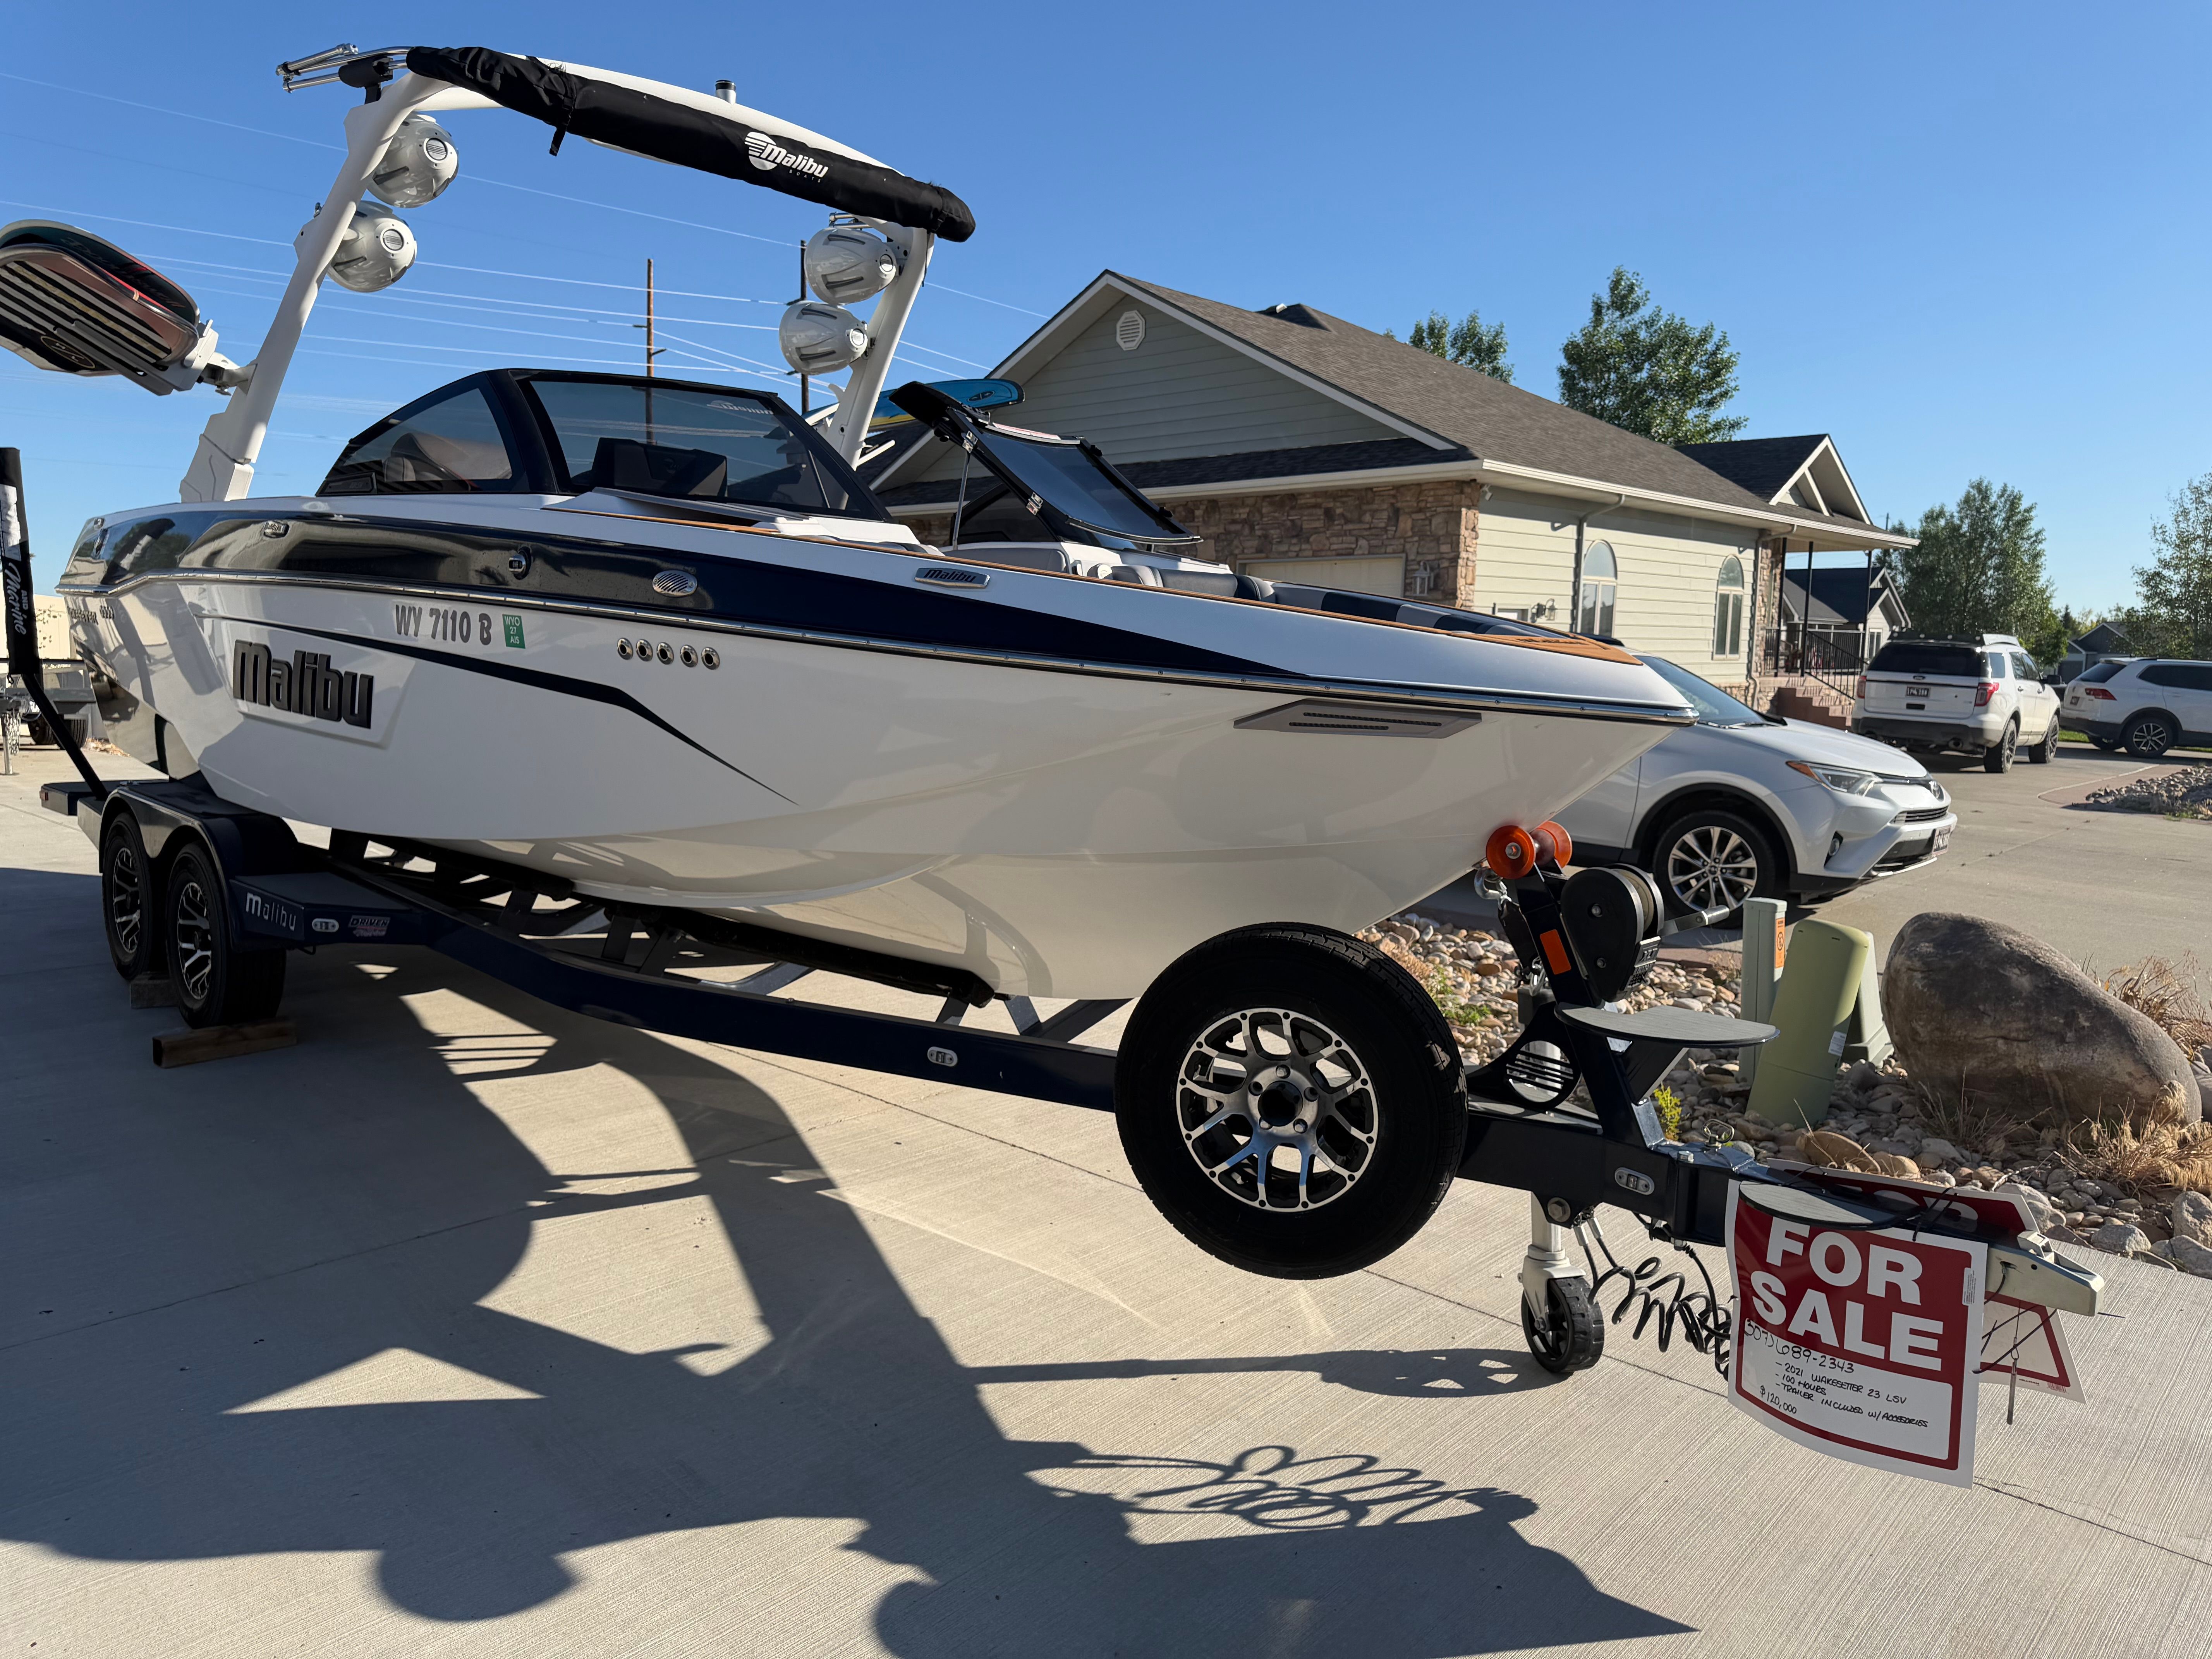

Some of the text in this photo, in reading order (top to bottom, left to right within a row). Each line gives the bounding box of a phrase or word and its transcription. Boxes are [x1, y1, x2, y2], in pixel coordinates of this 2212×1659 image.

[760, 144, 828, 177] Malibu
[789, 169, 821, 183] BOATS
[923, 569, 976, 582] Malibu
[5, 562, 27, 635] Marine
[395, 605, 492, 646] WY 7110 B
[504, 616, 520, 626] WYO
[233, 639, 374, 729] Malibu
[1766, 1216, 1923, 1306] FOR
[1750, 1271, 1944, 1371] SALE
[1760, 1385, 1797, 1414] $120,000
[1781, 1382, 1814, 1401] TRAILER
[1822, 1399, 1863, 1414] INCLUDED
[1783, 1374, 1795, 1384] 100
[1798, 1381, 1827, 1396] HOURS
[1785, 1363, 1803, 1377] 2021
[1812, 1374, 1863, 1393] WAKESETTER
[1867, 1389, 1880, 1399] 23
[1886, 1395, 1907, 1404] LSV
